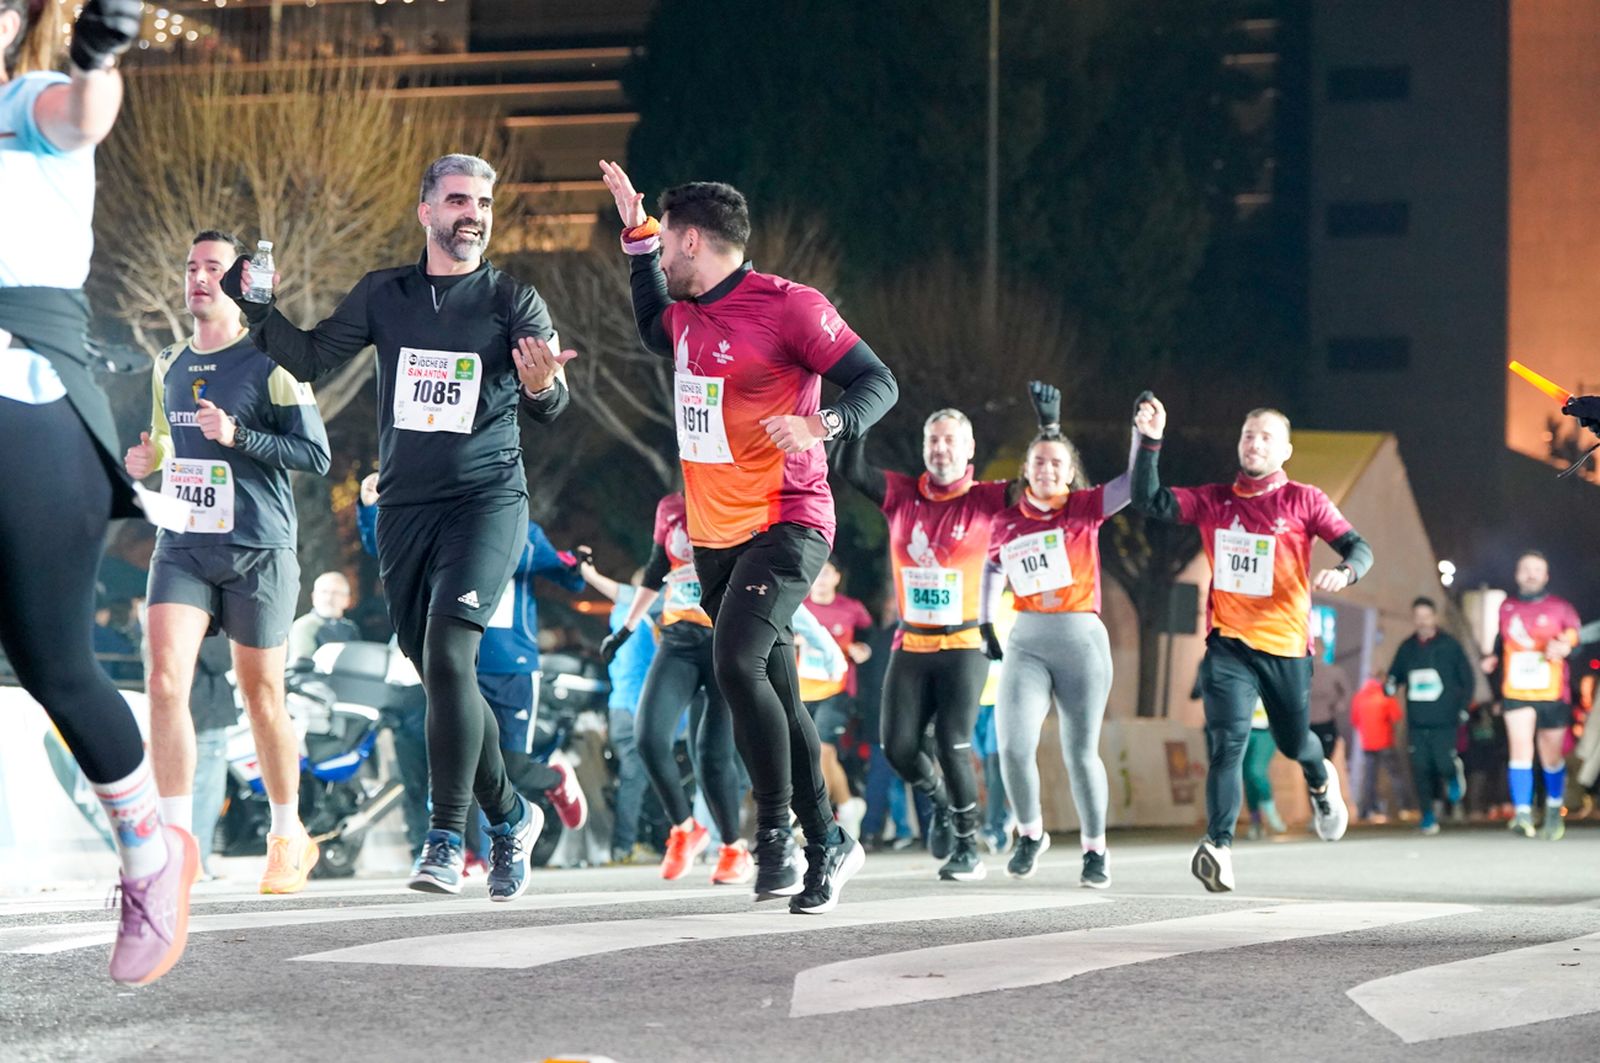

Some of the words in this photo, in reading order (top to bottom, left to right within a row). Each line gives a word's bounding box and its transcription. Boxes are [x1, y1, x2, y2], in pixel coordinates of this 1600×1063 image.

[188, 364, 217, 372] KELME
[408, 367, 422, 377] SAN
[413, 379, 461, 405] 1085
[175, 485, 216, 508] 7448
[1021, 553, 1048, 574] 104
